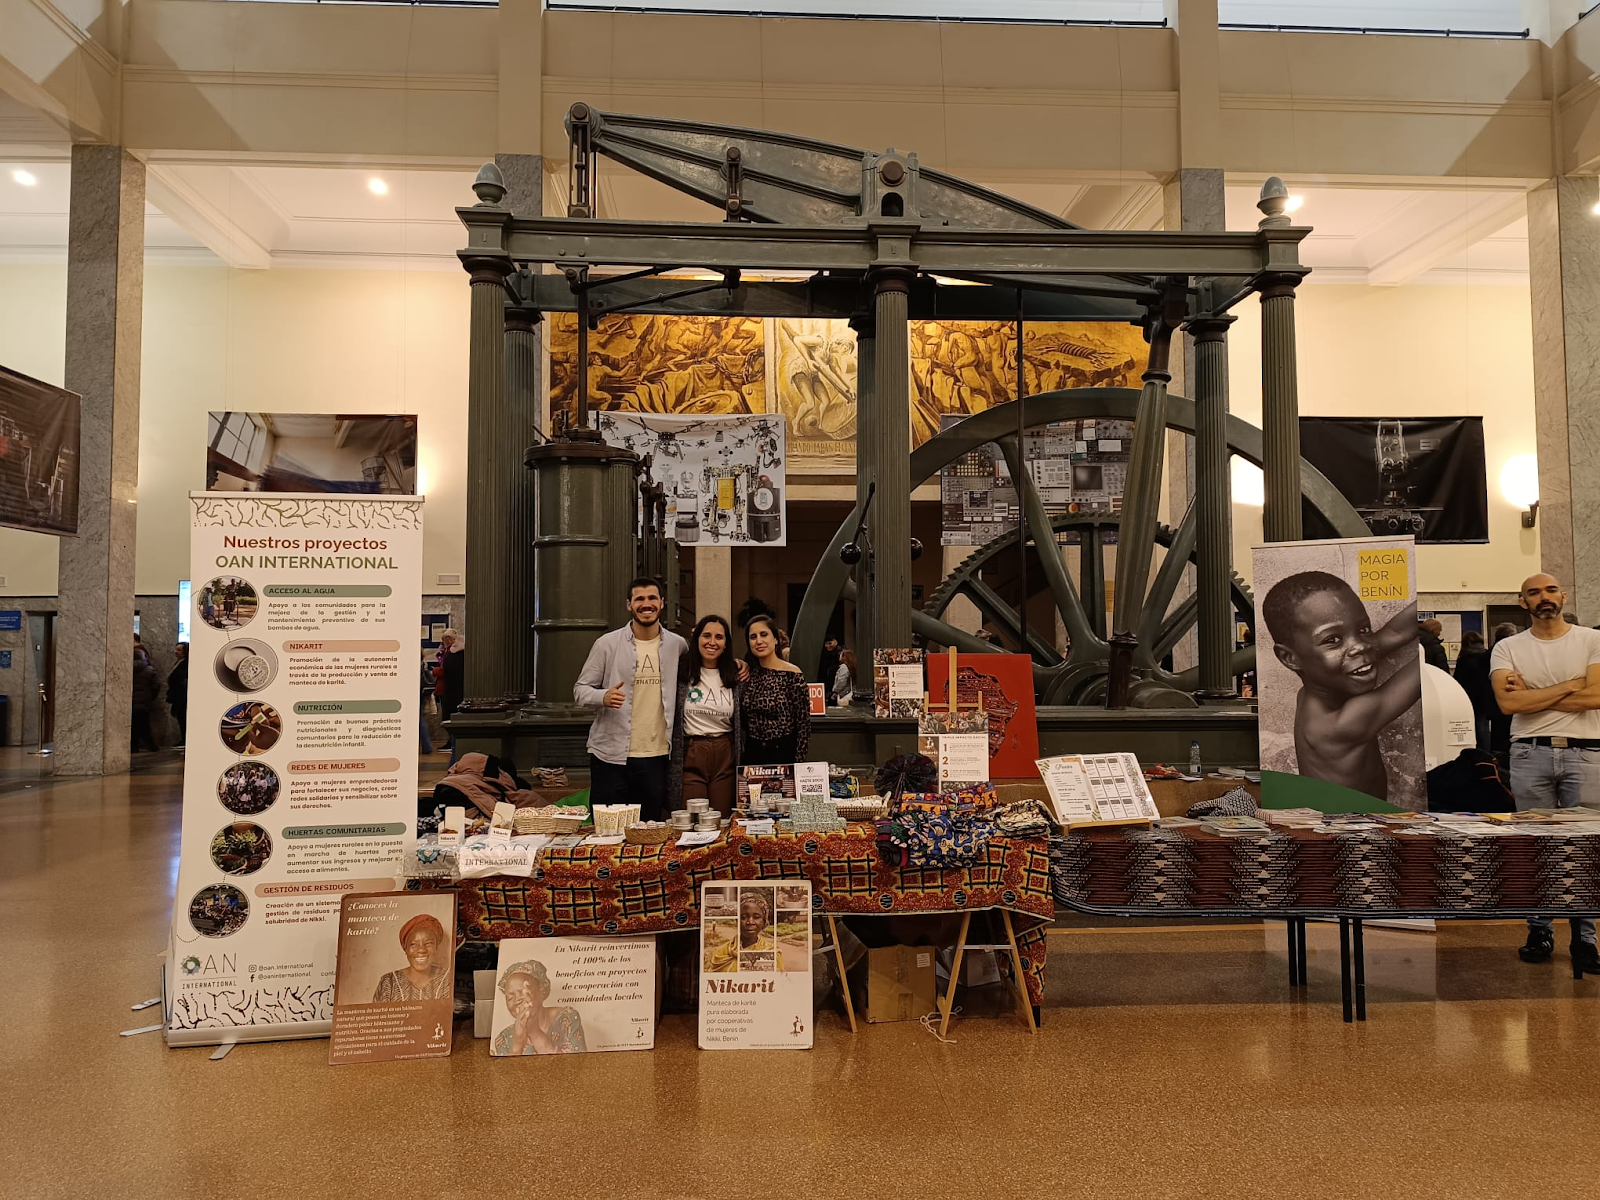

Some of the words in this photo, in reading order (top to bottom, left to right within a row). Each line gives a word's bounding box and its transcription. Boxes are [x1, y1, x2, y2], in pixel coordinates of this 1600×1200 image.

[224, 536, 300, 549] Nuestros
[305, 538, 387, 552] proyectos
[215, 556, 253, 568] OAN
[260, 556, 398, 569] INTERNATIONAL
[1360, 554, 1405, 565] MAGIA
[1360, 571, 1389, 581] POR
[1361, 584, 1402, 597] BENÍN
[748, 767, 784, 776] Nikarit
[264, 885, 300, 894] GESTIÓN
[347, 903, 387, 911] ¿Conoces
[347, 927, 379, 936] karité?
[568, 944, 597, 952] Nikarit
[599, 943, 650, 951] reinvertimos
[258, 971, 312, 980] @oaninternational
[556, 970, 595, 978] beneficios
[608, 969, 647, 977] proyectos
[182, 981, 237, 989] INTERNATIONAL
[574, 981, 623, 990] cooperación
[705, 979, 775, 994] Nikarit
[557, 994, 612, 1003] comunidades
